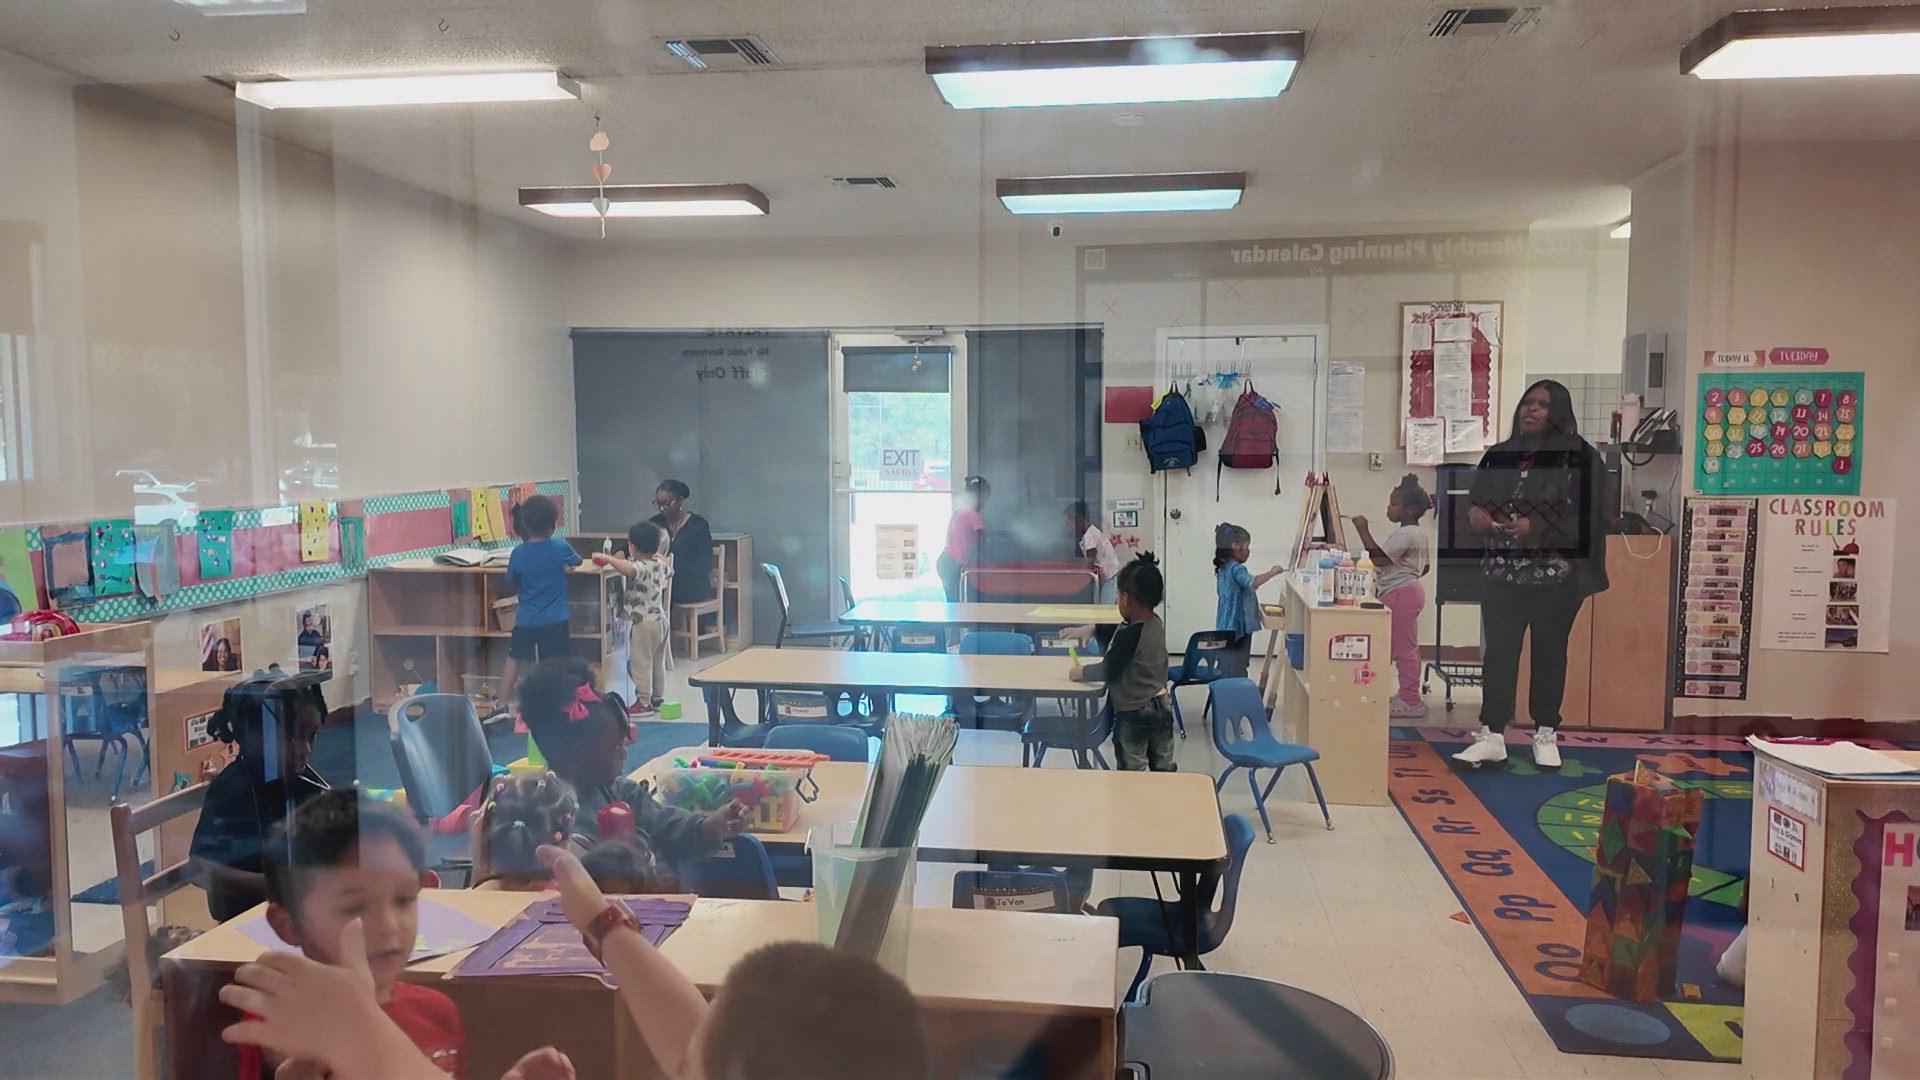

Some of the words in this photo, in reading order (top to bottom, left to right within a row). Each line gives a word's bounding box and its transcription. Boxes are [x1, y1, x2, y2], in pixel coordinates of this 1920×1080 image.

[1718, 353, 1741, 363] TODAY
[1743, 353, 1751, 362] IS
[1780, 351, 1818, 362] TUESDAY
[882, 449, 919, 467] EXIT
[1769, 497, 1885, 518] CLASSROOM
[1795, 518, 1857, 537] RULES
[1412, 788, 1455, 806] Ss
[1432, 816, 1480, 835] Rr
[1564, 812, 1601, 825] 12
[1785, 830, 1803, 847] Games
[1884, 832, 1920, 867] H
[1461, 849, 1514, 877] Qq
[1493, 894, 1557, 922] Pp
[1534, 943, 1582, 982] Oo
